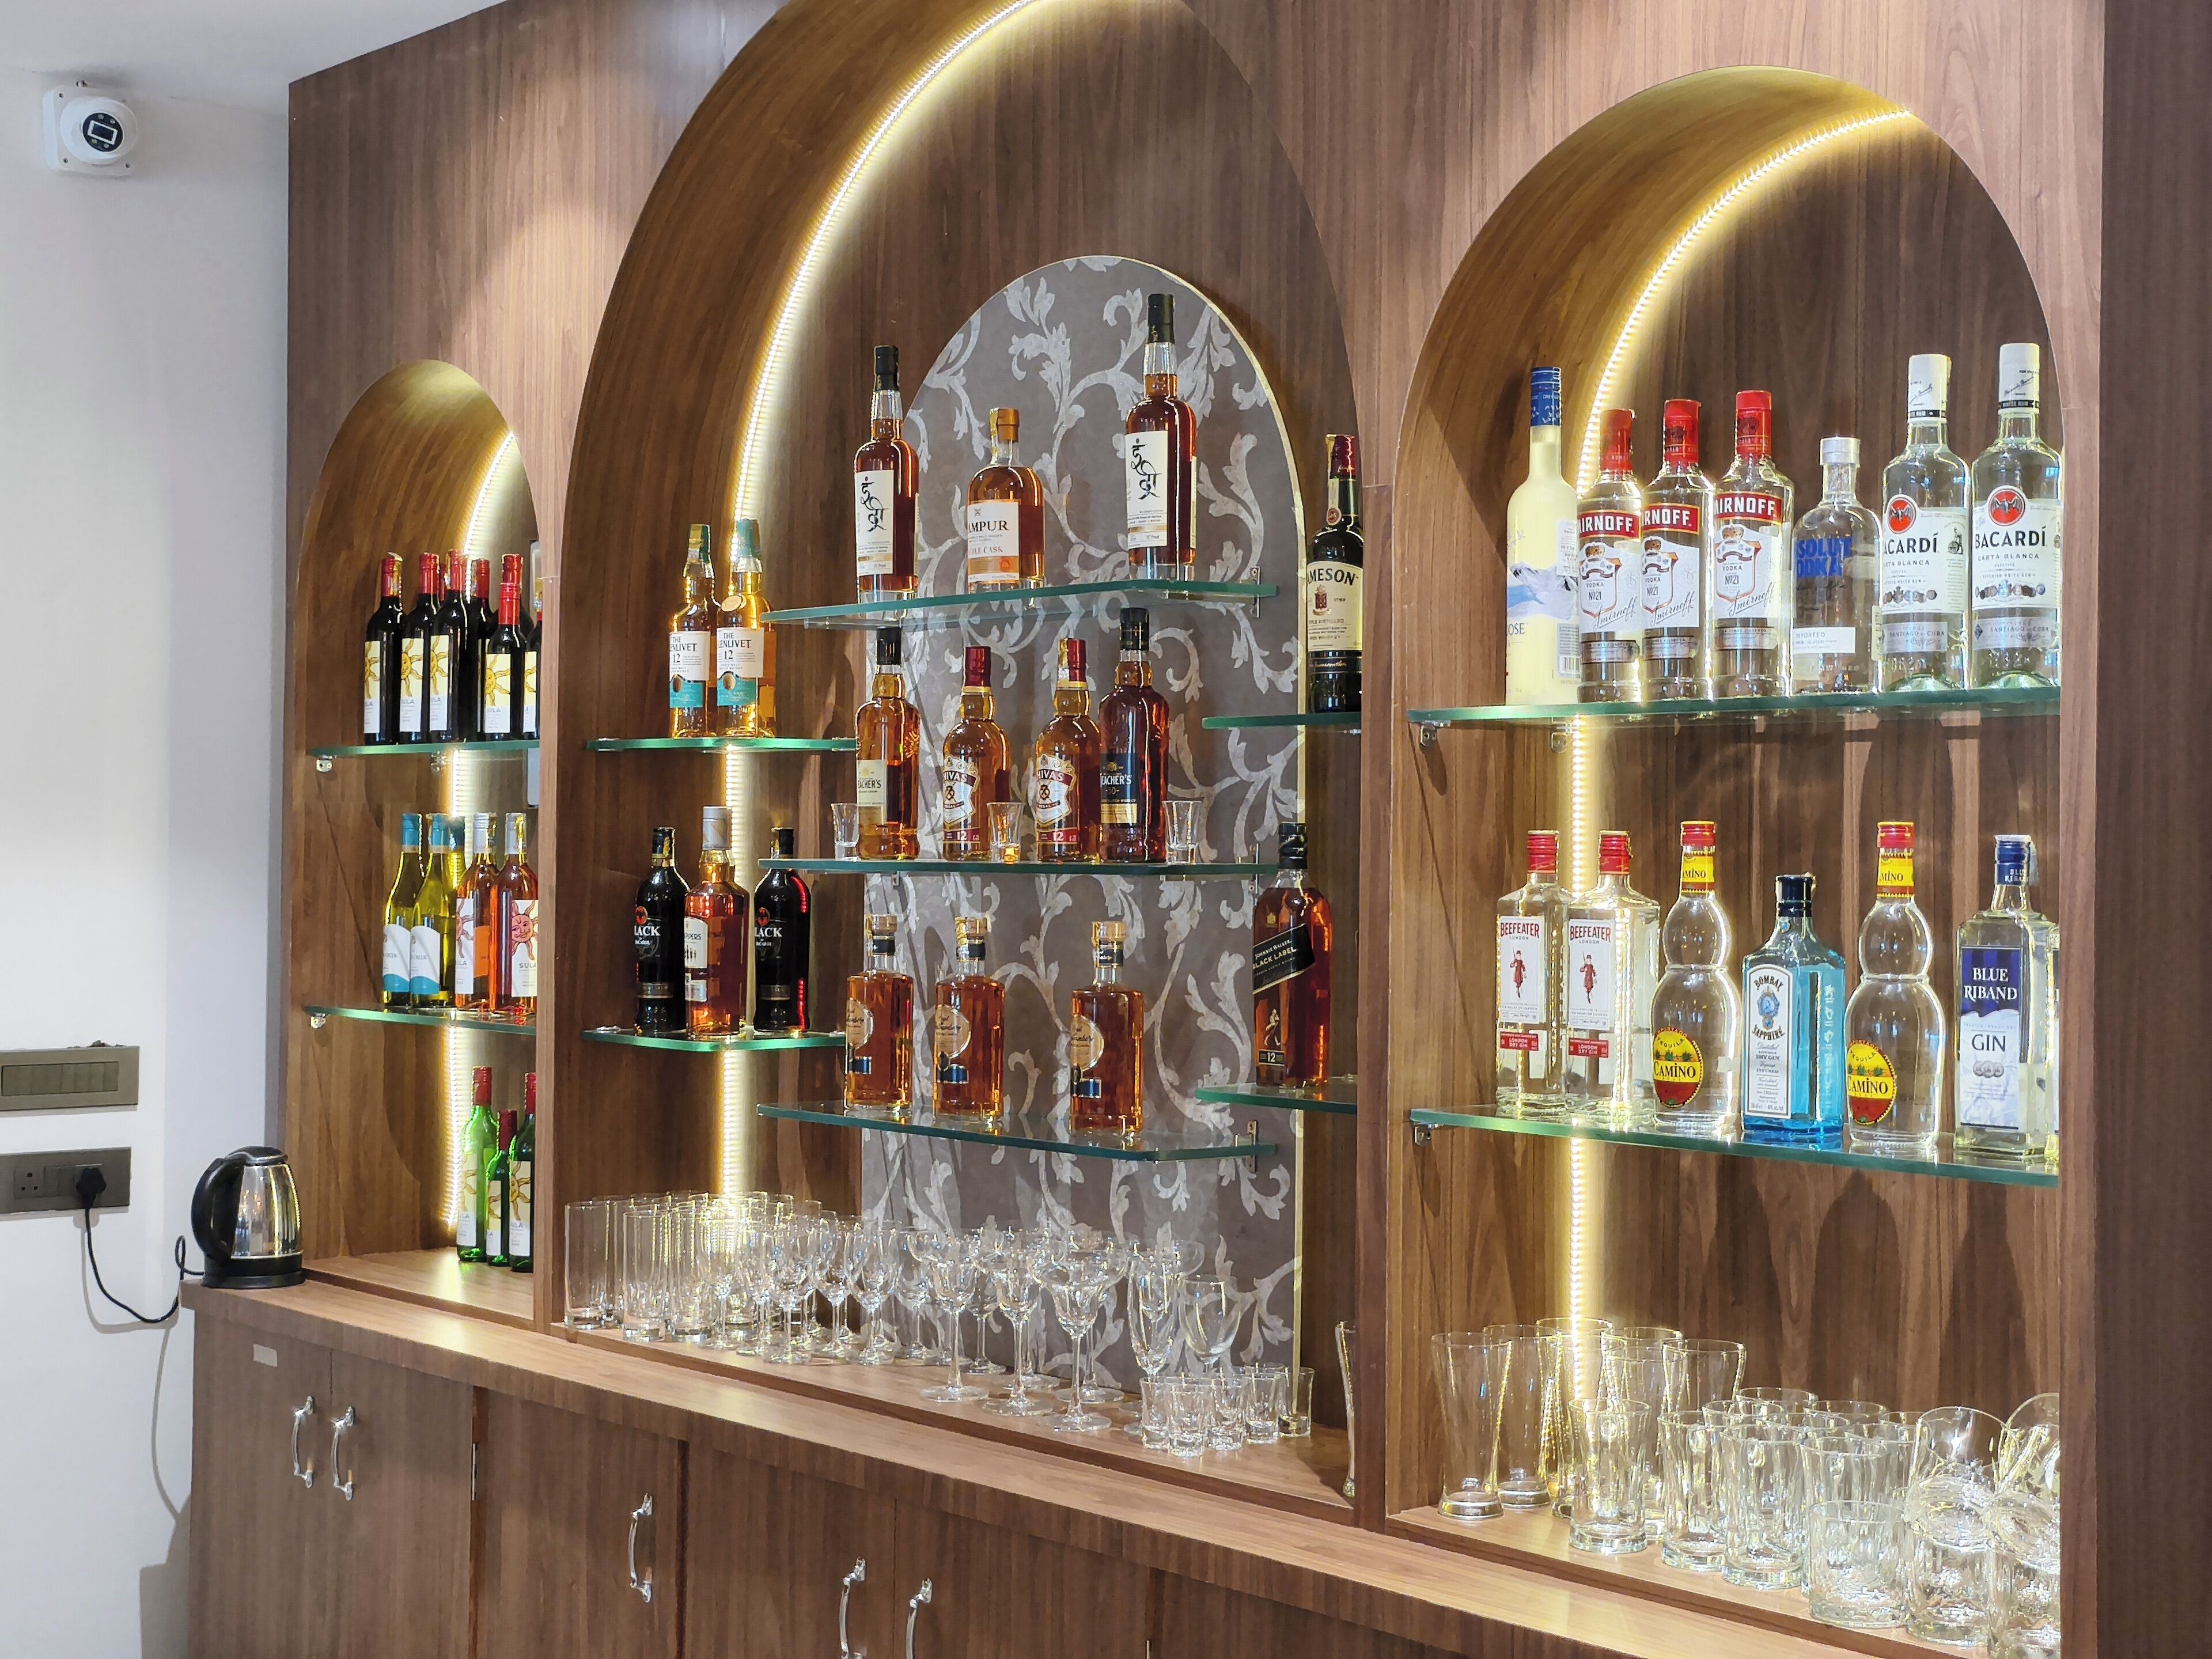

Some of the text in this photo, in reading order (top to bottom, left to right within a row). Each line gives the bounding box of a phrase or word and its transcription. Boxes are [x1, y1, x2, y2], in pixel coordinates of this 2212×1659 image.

[1975, 525, 2047, 549] BACARDÍ
[673, 653, 681, 664] 12
[724, 650, 734, 660] 12
[956, 830, 968, 841] 12
[1052, 831, 1065, 842] 12
[1500, 922, 1540, 939] BEEFEATER
[1569, 925, 1611, 942] BEEFEATER
[1274, 946, 1298, 960] LABEL
[1972, 967, 2009, 982] BLUE
[1753, 975, 1783, 992] BOMBAY
[1963, 985, 2018, 1003] RIBAND
[1752, 1024, 1785, 1041] SAPPHIRE
[1657, 1037, 1684, 1048] TEQUILA
[1971, 1033, 2006, 1052] GIN
[1267, 1051, 1277, 1063] 12
[1850, 1050, 1876, 1062] TEQUILA
